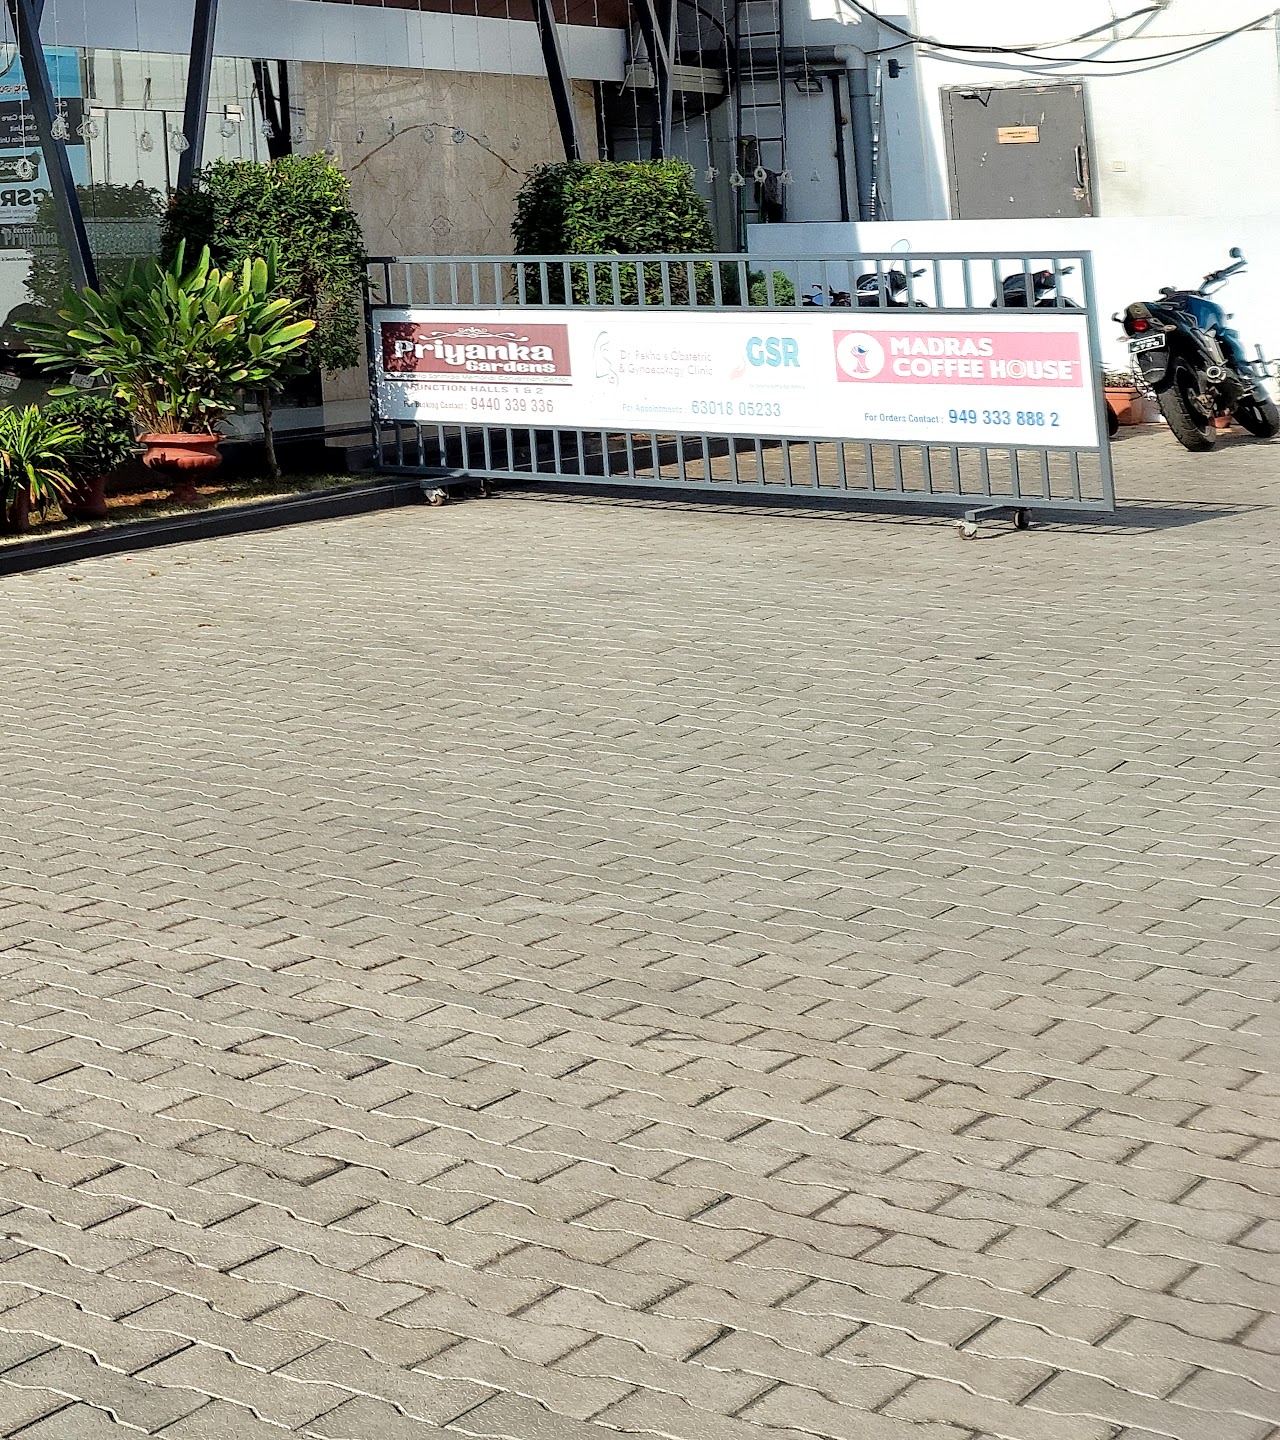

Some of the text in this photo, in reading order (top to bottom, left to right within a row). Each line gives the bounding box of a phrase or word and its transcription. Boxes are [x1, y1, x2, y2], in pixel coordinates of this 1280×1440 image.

[394, 339, 554, 366] Priyanka
[746, 336, 800, 367] GSR
[890, 336, 993, 357] MADRAS
[465, 359, 557, 374] Gardens
[687, 364, 713, 376] Clinic
[893, 357, 1073, 380] COFFEE HOUSE
[470, 385, 509, 394] HALLS
[535, 387, 544, 396] 2
[470, 396, 501, 411] 9440
[504, 397, 527, 412] 339
[530, 398, 555, 413] 336
[691, 400, 734, 416] 63018
[738, 401, 782, 417] 05233
[864, 412, 878, 422] For
[879, 413, 907, 423] Orders
[908, 414, 940, 424] Contact
[948, 409, 977, 424] 949
[982, 410, 1012, 426] 333
[1016, 411, 1046, 427] 888
[1049, 412, 1060, 427] 2
